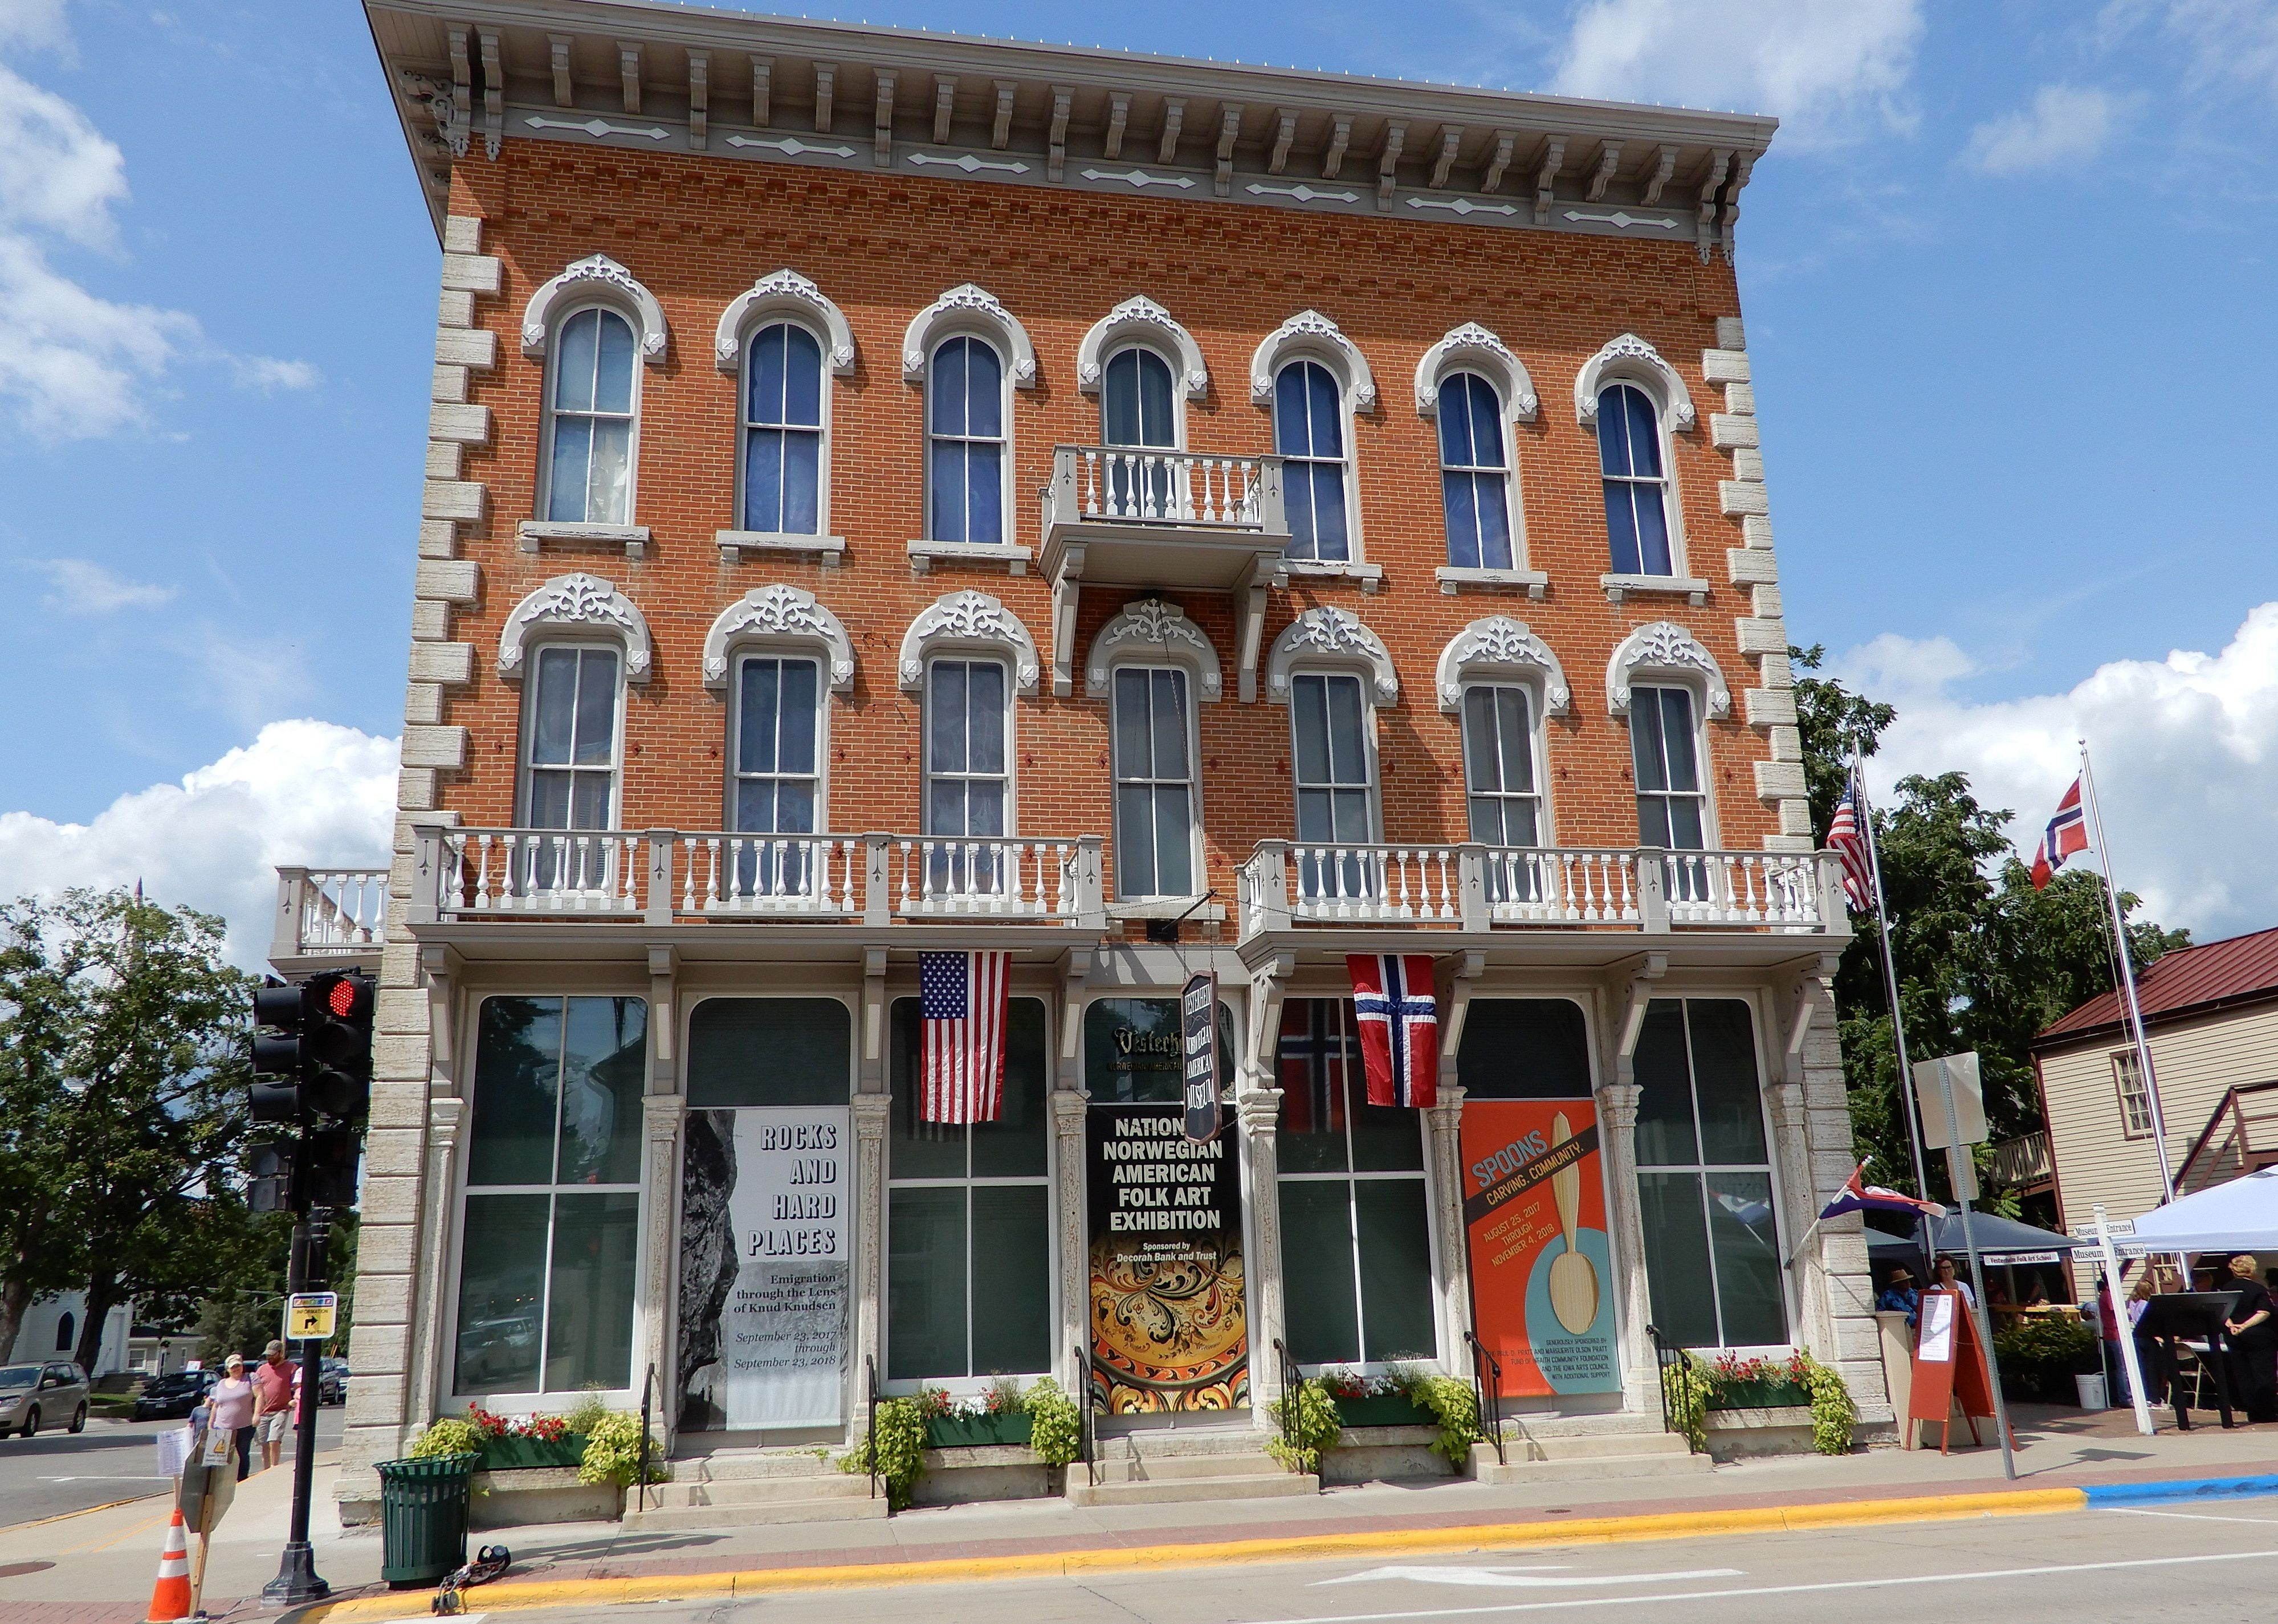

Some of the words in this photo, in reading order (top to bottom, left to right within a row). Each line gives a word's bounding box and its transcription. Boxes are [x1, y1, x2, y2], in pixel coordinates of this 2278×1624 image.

[1186, 1025, 1212, 1055] NORWEGIAN
[1187, 1053, 1213, 1080] AMERICAN
[761, 1124, 837, 1150] ROCKS
[1115, 1117, 1185, 1137] NATION
[1103, 1140, 1222, 1160] NORWEGIAN
[1472, 1130, 1547, 1188] SPOONS
[790, 1158, 837, 1184] AND
[1112, 1164, 1215, 1184] AMERICAN
[1486, 1174, 1530, 1206] CARVING.
[1529, 1141, 1584, 1180] COMMUNITY.
[772, 1193, 836, 1219] HARD
[1119, 1188, 1169, 1207] FOLK
[1174, 1186, 1211, 1206] ART
[1110, 1210, 1220, 1231] EXHIBITION
[1483, 1220, 1510, 1243] AUGUST
[1523, 1201, 1540, 1218] 2017
[2106, 1223, 2132, 1233] Entrance
[748, 1227, 836, 1256] PLACES
[1501, 1221, 1534, 1246] THROUGH
[1143, 1242, 1180, 1252] Sponsored
[1181, 1241, 1190, 1251] by
[1491, 1239, 1528, 1267] NOVEMBER
[1536, 1223, 1555, 1240] 2018
[2073, 1250, 2104, 1259] Museum
[2114, 1247, 2144, 1256] Entrance
[1116, 1252, 1152, 1263] Decorah
[1154, 1252, 1176, 1262] Bank
[1177, 1252, 1194, 1261] and
[1196, 1251, 1217, 1260] Trust
[770, 1273, 836, 1286] Emigration
[736, 1288, 784, 1301] through
[786, 1288, 806, 1297] the
[809, 1288, 837, 1297] Lens
[733, 1303, 747, 1313] of
[749, 1302, 781, 1313] Knud
[784, 1300, 836, 1312] Knudsen
[736, 1331, 792, 1345] September
[812, 1331, 837, 1341] 2017
[794, 1342, 836, 1354] through
[734, 1357, 790, 1373] September
[792, 1357, 808, 1368] 23,
[810, 1354, 836, 1365] 2018
